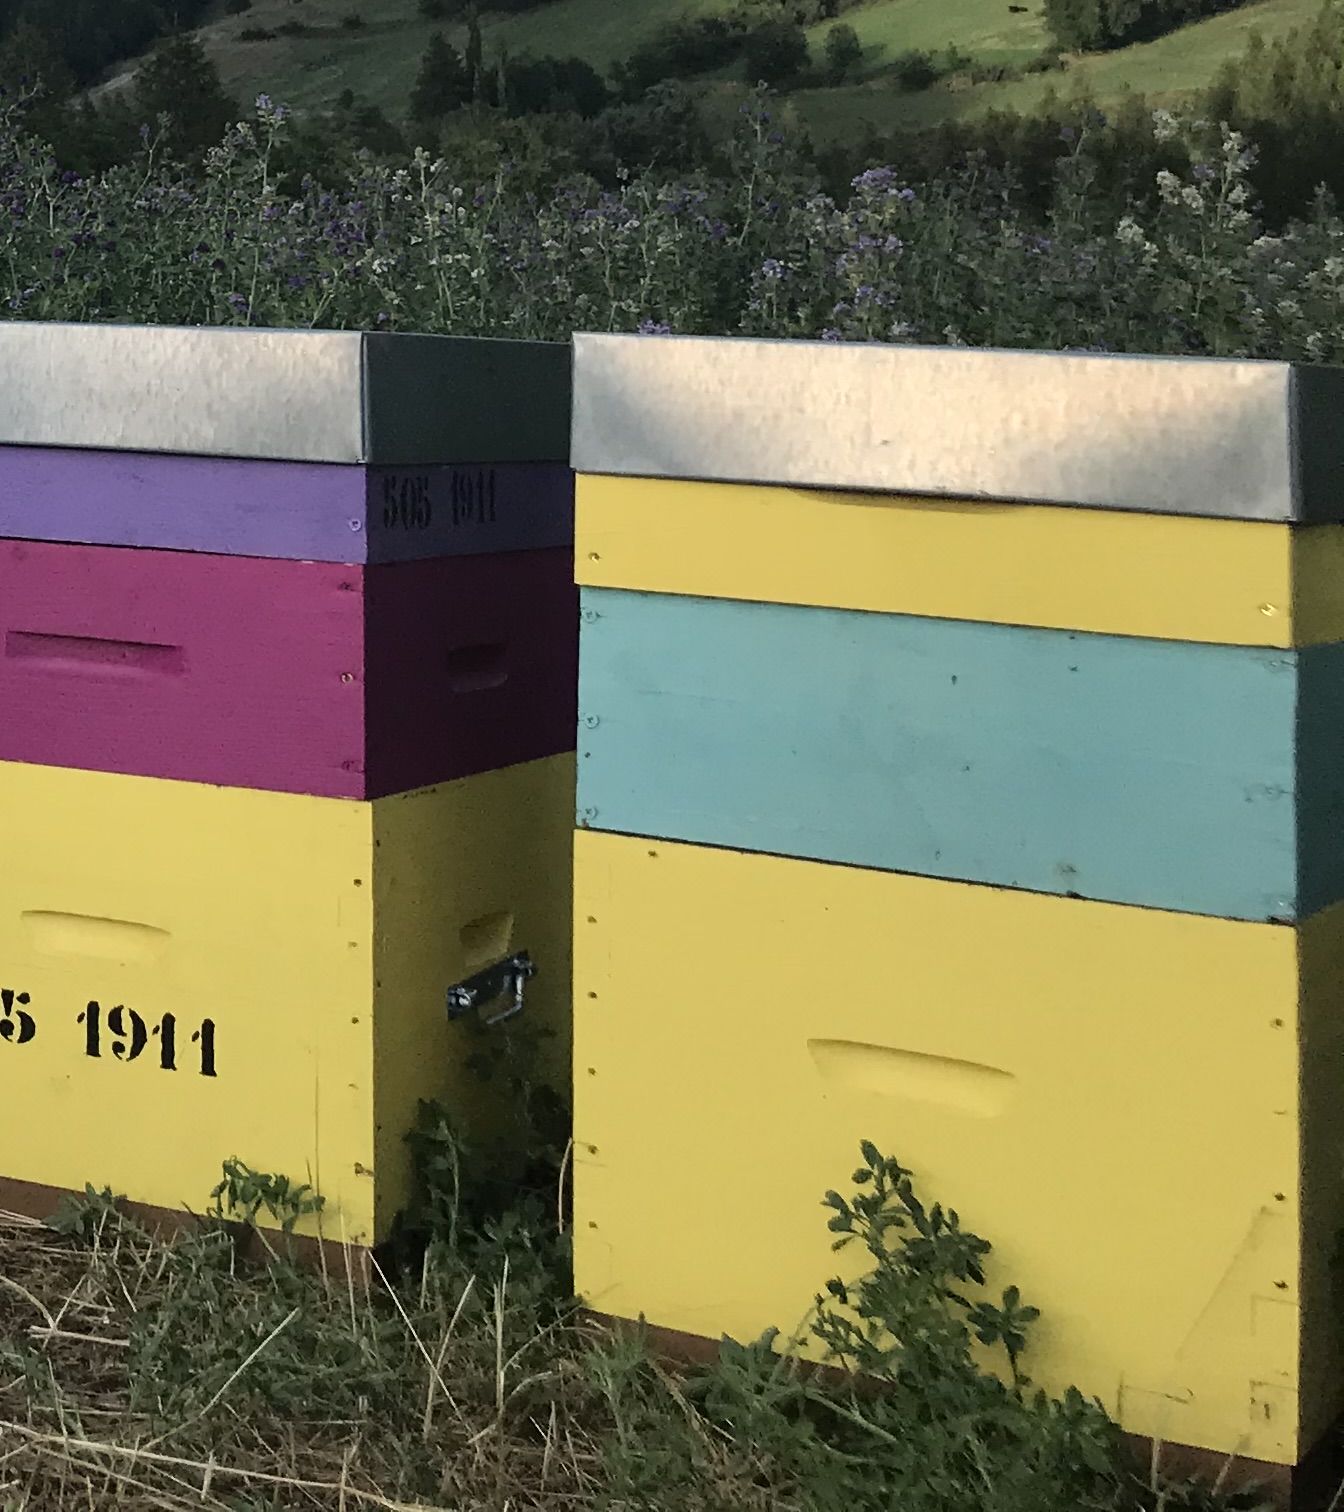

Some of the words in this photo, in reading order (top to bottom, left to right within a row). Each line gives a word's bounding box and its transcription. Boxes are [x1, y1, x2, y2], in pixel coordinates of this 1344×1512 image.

[382, 474, 432, 530] 505
[450, 469, 496, 526] 1911
[76, 1000, 218, 1077] 1911
